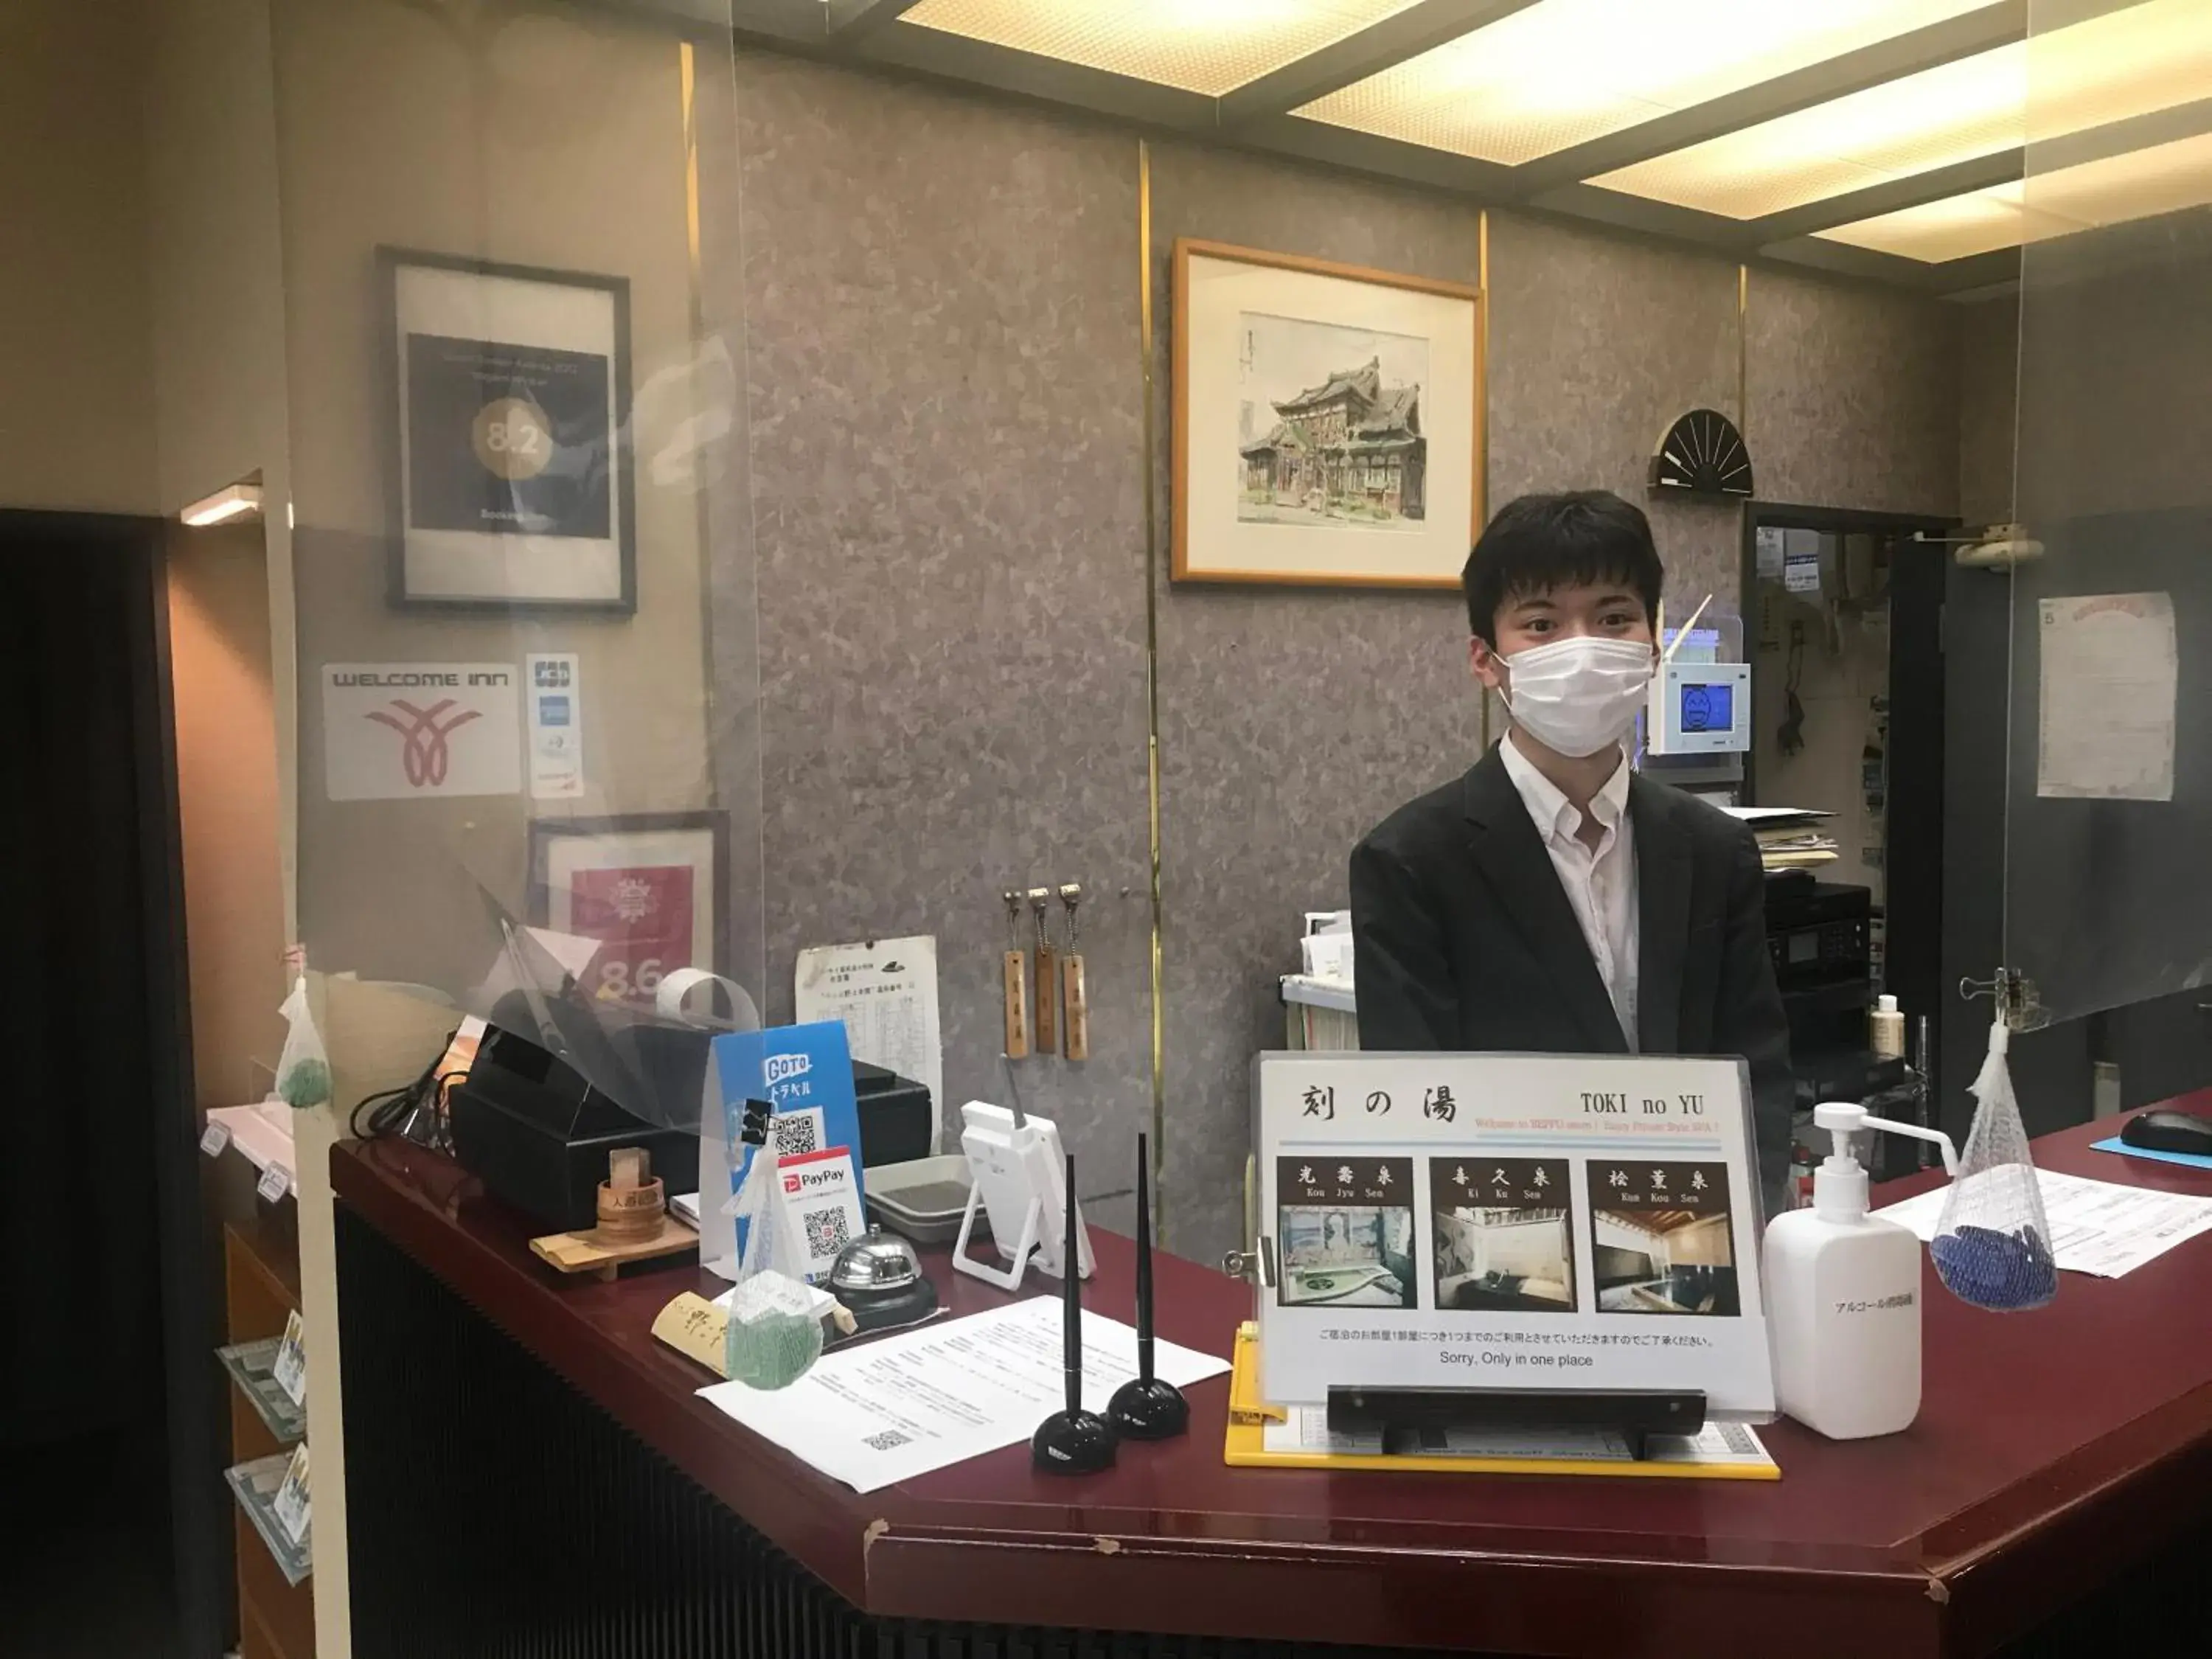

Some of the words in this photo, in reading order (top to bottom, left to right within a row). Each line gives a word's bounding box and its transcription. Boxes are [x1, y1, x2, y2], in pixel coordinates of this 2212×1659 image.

[487, 422, 538, 453] 8.2
[332, 673, 459, 686] WELCOME
[599, 959, 664, 998] 8.6
[771, 1081, 811, 1100] トラベル
[1580, 1093, 1627, 1113] TOKI
[1643, 1099, 1666, 1115] no
[1678, 1095, 1704, 1116] YU
[801, 1169, 845, 1187] PayPay
[1307, 1188, 1326, 1198] Kou
[1335, 1188, 1355, 1198] Jyu
[1365, 1188, 1385, 1198] Sen
[1835, 1292, 1912, 1314] アルコール
[1439, 1351, 1479, 1367] Sorry,
[1481, 1352, 1512, 1368] Only
[1515, 1352, 1527, 1365] in
[1530, 1354, 1555, 1366] one
[1558, 1354, 1593, 1368] place
